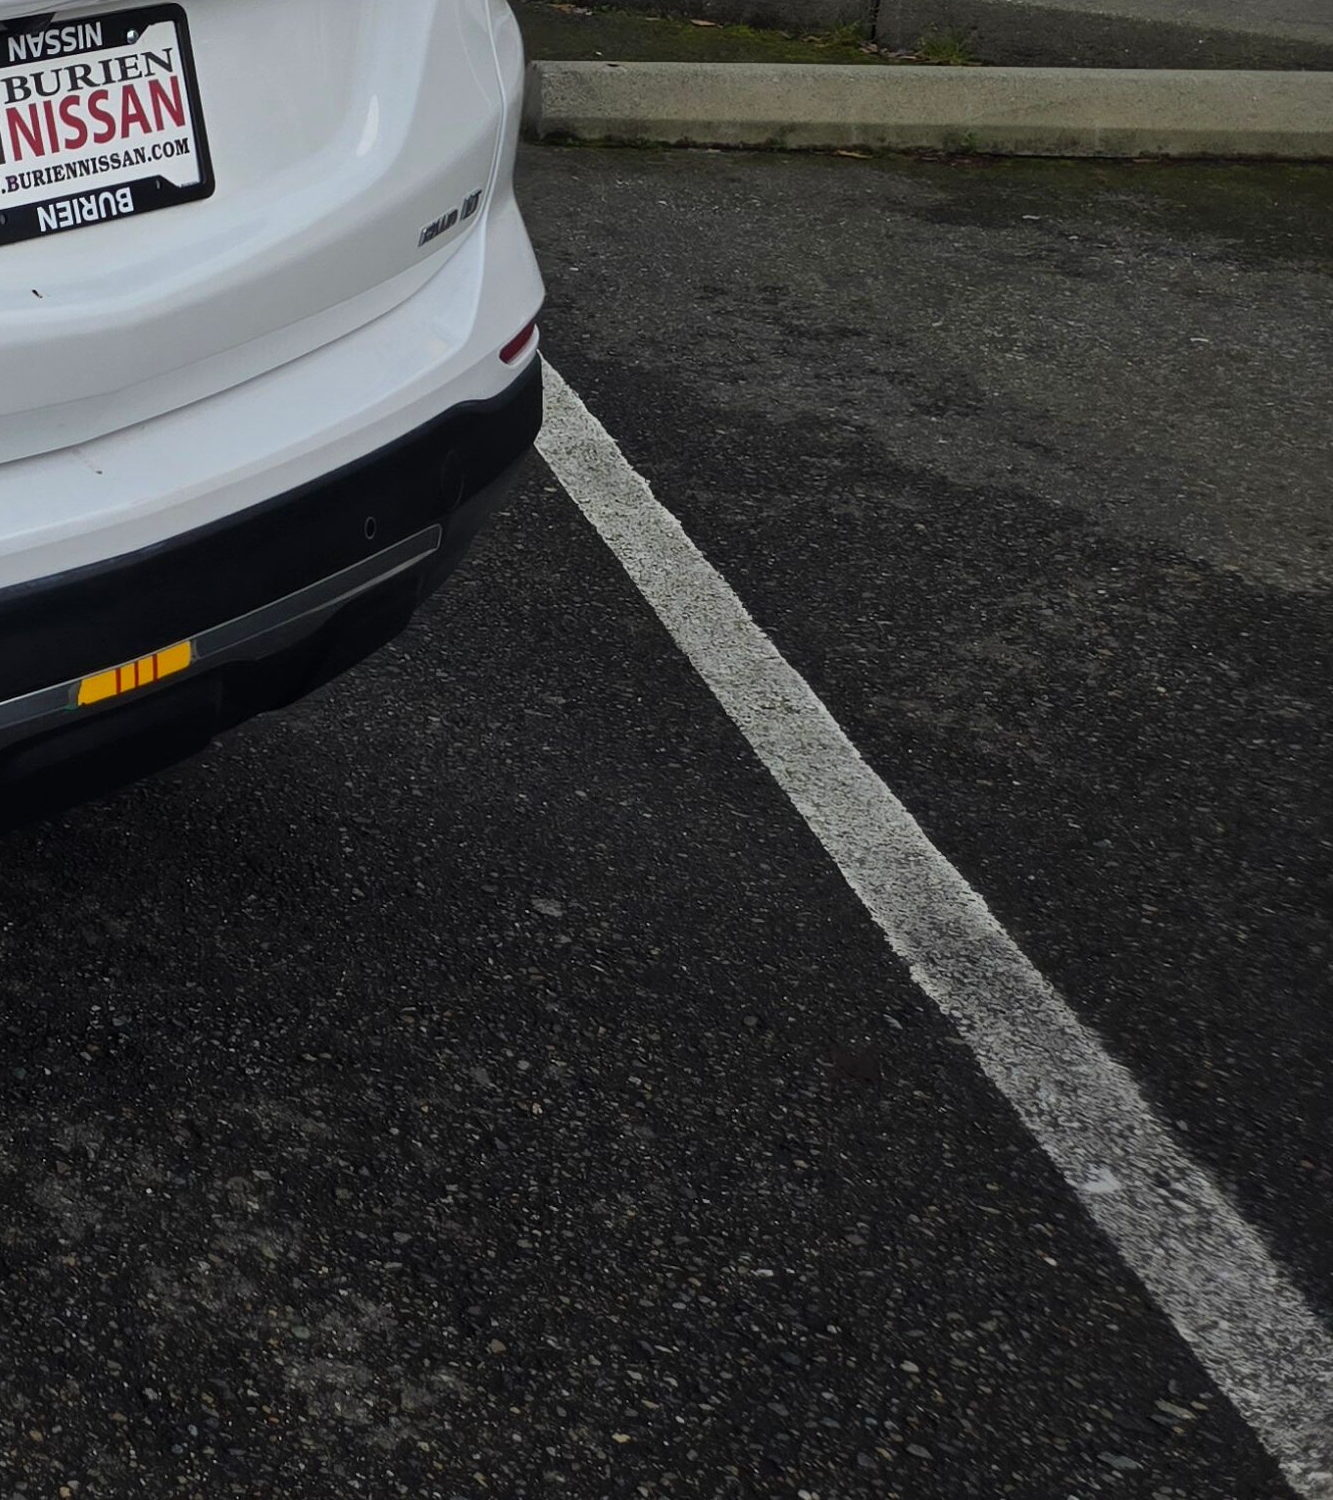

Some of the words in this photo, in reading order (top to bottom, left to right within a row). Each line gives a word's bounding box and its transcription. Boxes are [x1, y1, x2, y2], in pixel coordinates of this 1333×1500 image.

[7, 21, 103, 62] NISSAN
[0, 47, 175, 104] BURIEN
[5, 75, 187, 161] NISSAN
[36, 187, 134, 232] BURIEN
